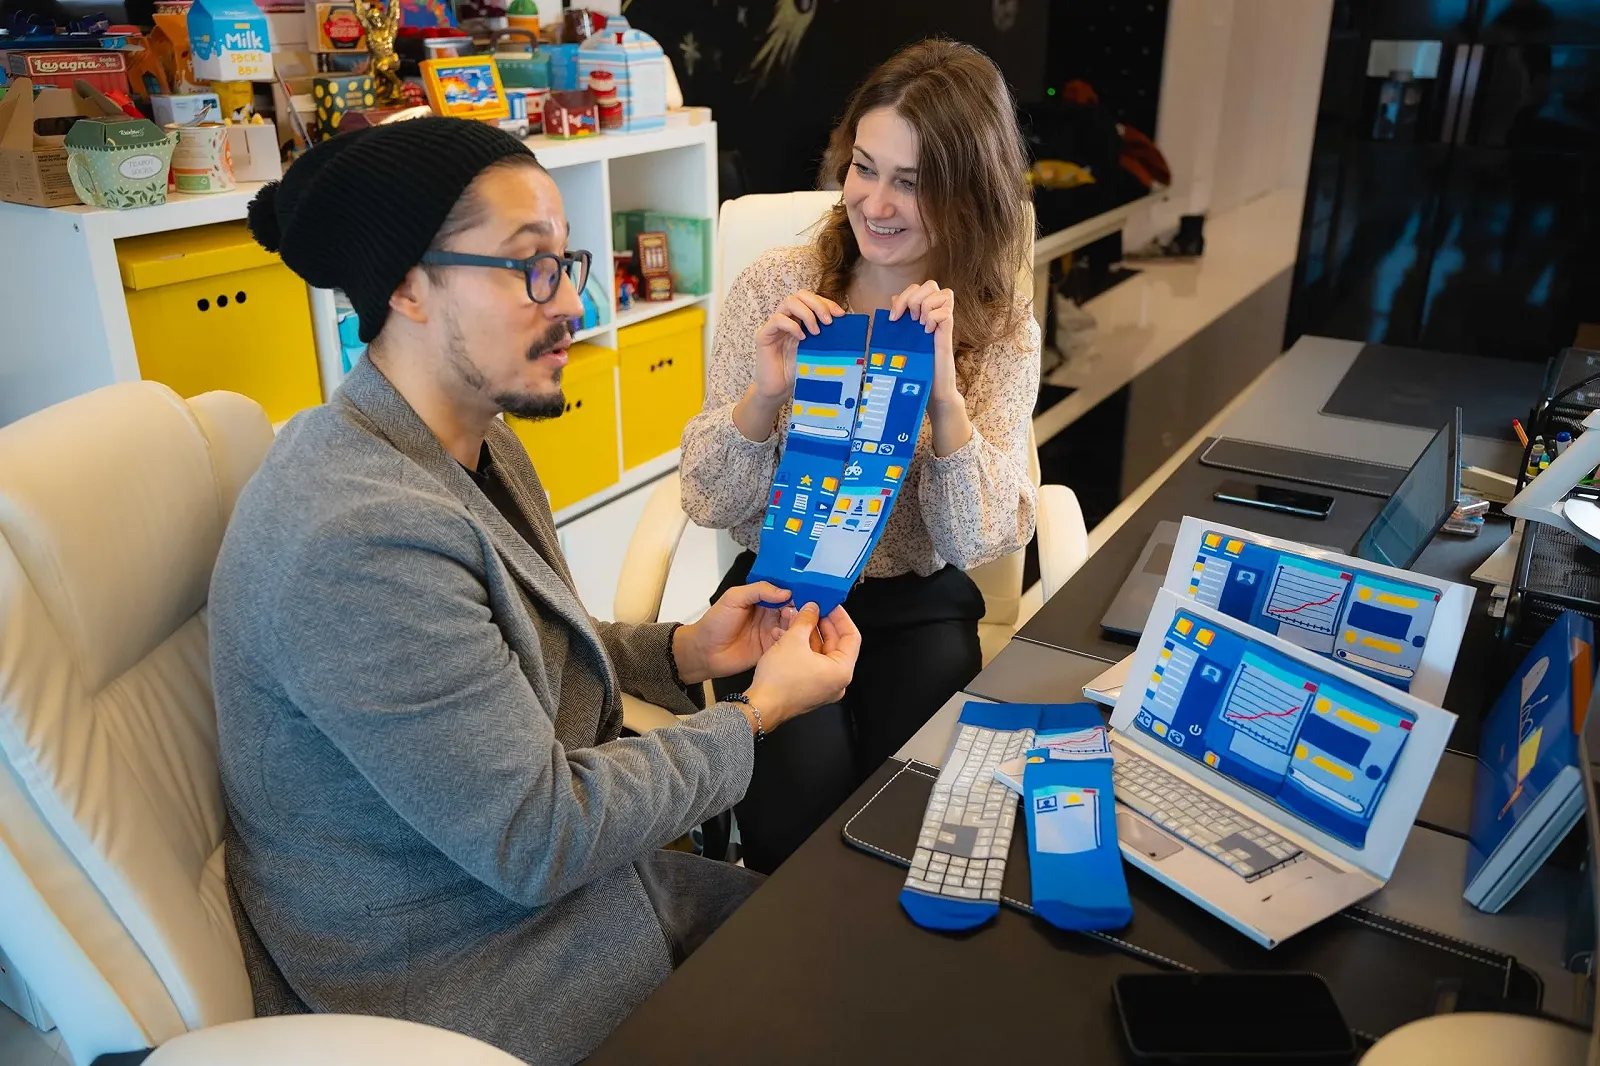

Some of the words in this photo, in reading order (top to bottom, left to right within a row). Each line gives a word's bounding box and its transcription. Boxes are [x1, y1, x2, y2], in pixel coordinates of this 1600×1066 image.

[225, 30, 263, 49] Milk
[34, 59, 101, 73] Lasagna
[127, 159, 154, 168] TEAPOT
[1138, 711, 1150, 726] PC
